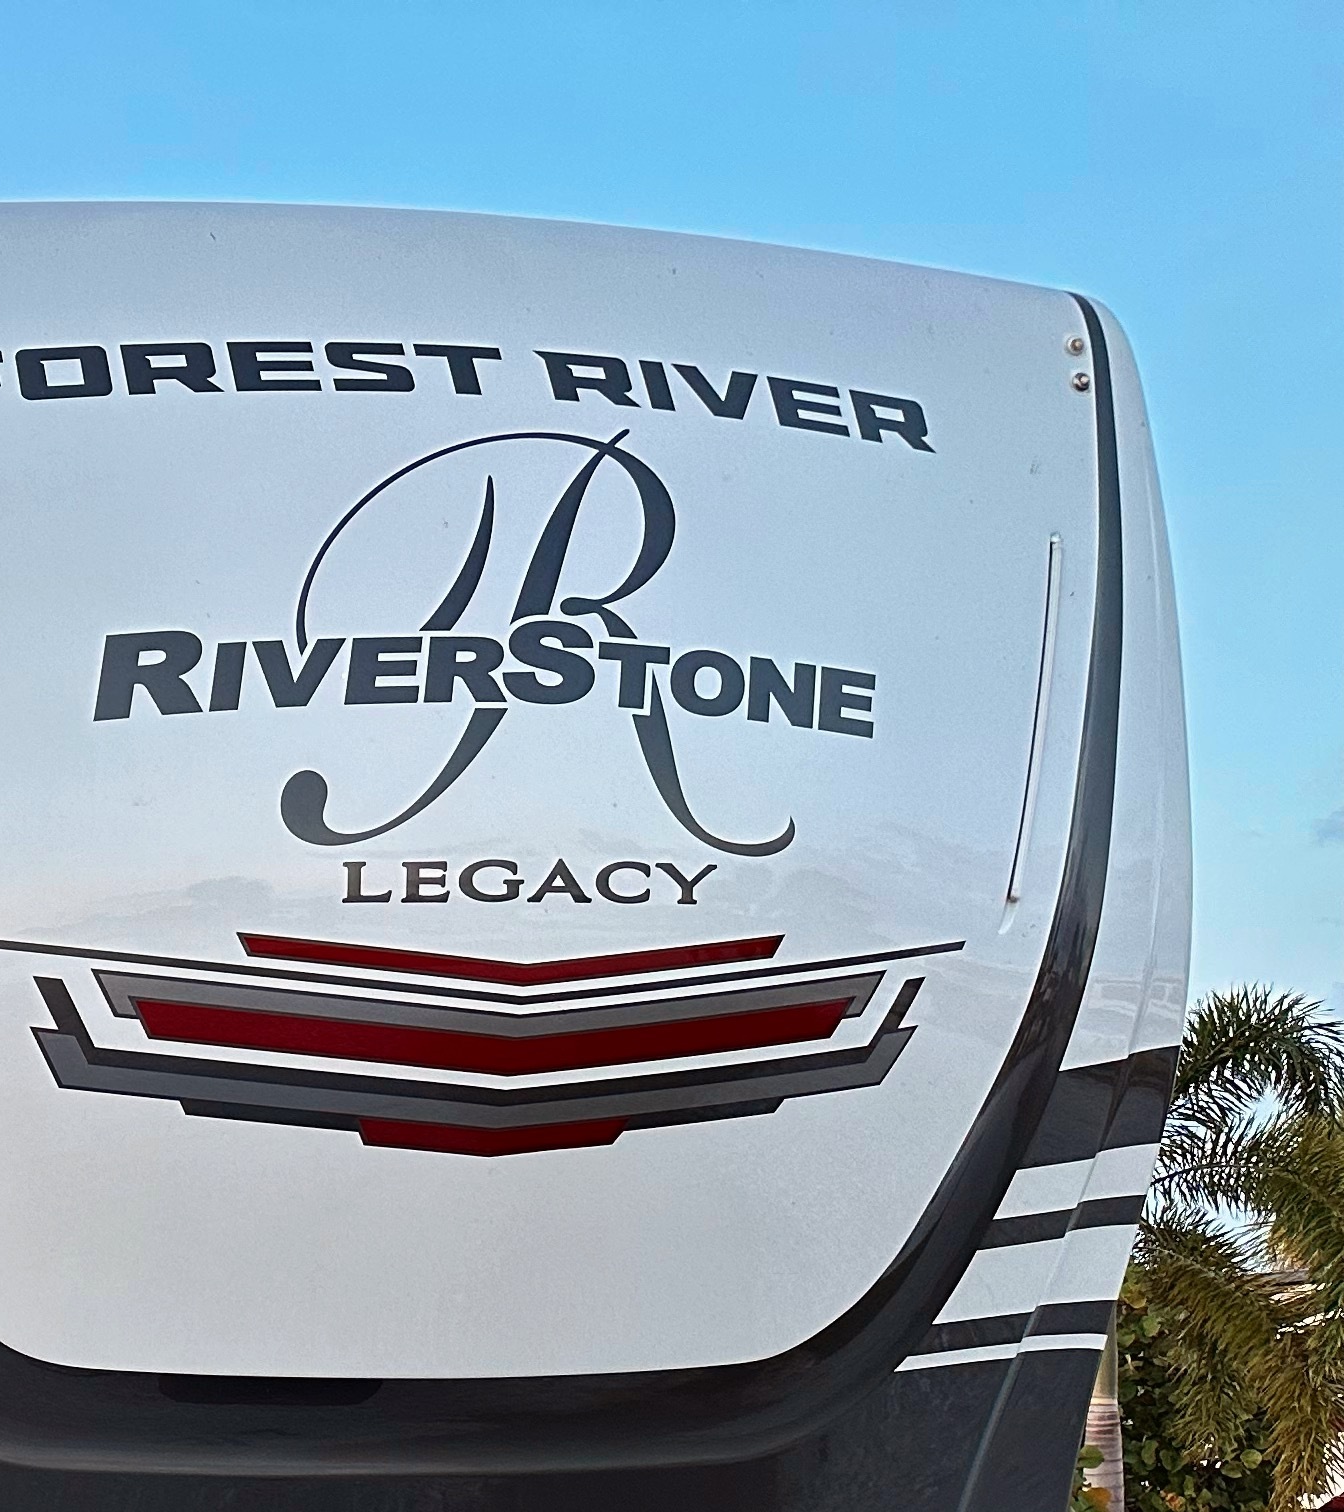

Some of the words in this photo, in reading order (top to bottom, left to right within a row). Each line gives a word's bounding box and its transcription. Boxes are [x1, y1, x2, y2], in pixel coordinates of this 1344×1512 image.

[532, 349, 936, 454] RIVER
[93, 620, 876, 739] RIVERSTONE
[341, 858, 718, 905] LEGACY
